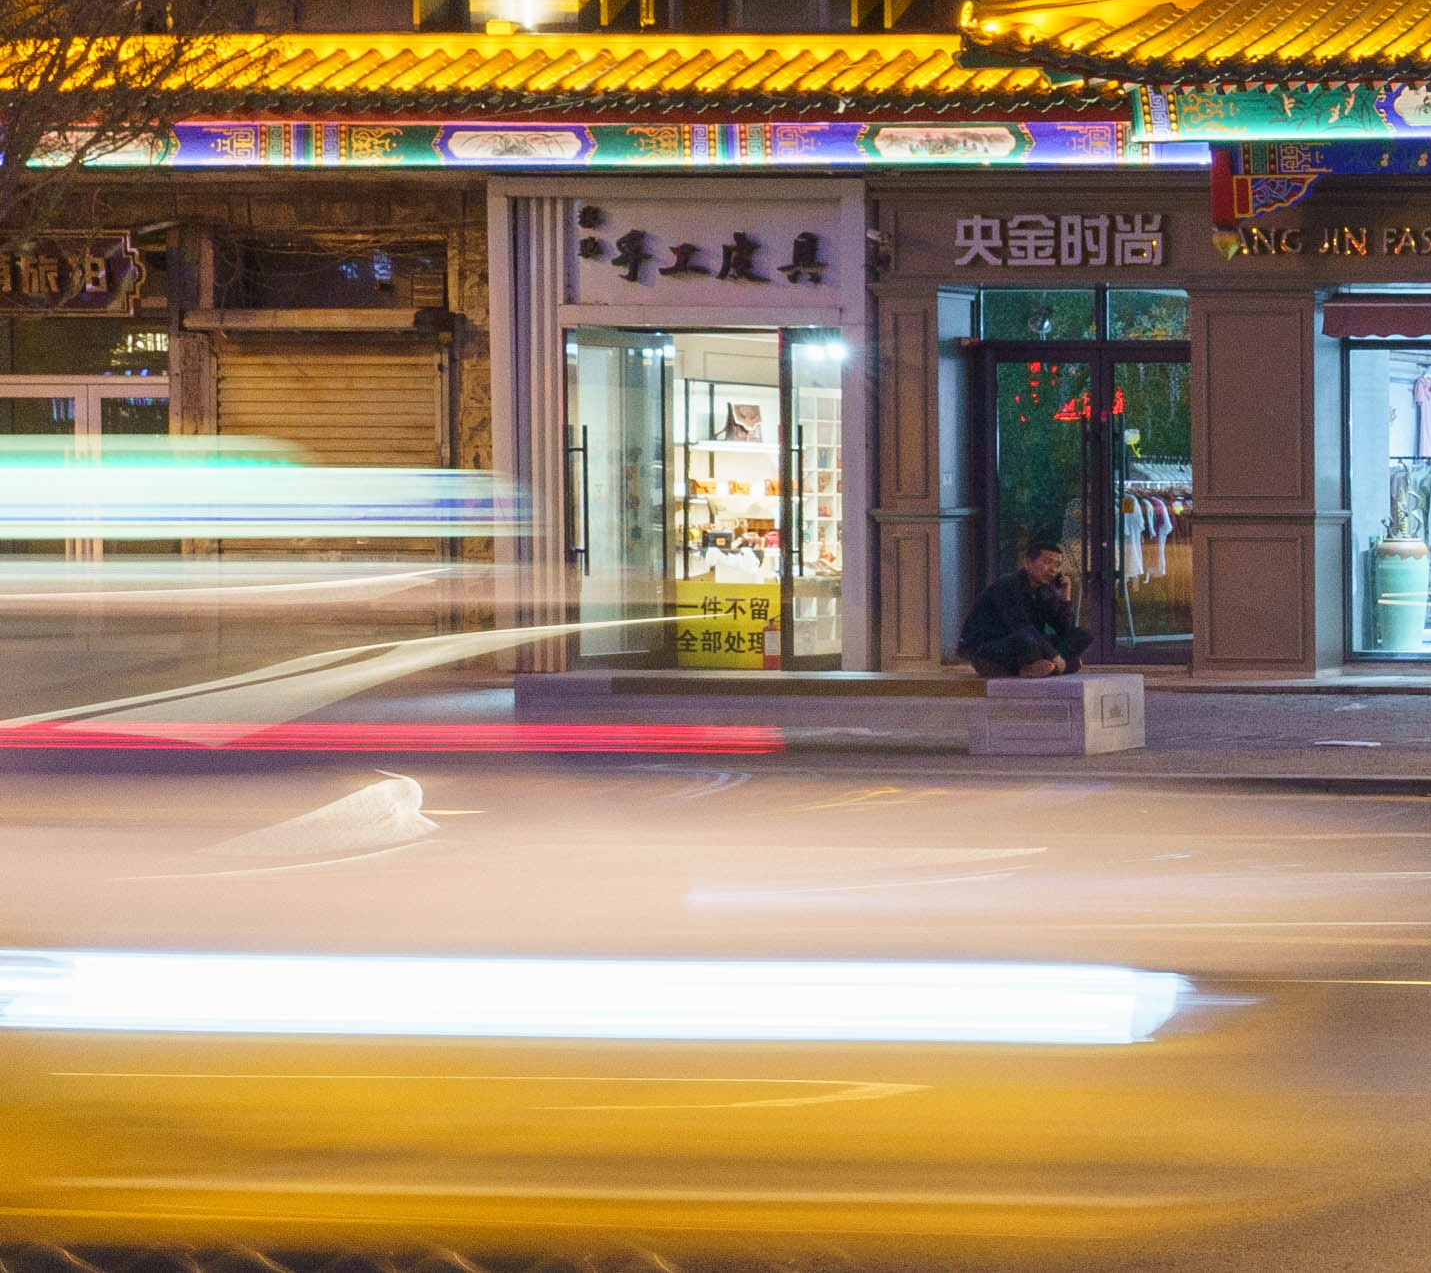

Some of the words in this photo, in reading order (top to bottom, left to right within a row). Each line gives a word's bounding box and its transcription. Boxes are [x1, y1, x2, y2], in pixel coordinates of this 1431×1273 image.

[954, 214, 1163, 265] 央金时尚
[1319, 227, 1367, 256] JIN
[611, 229, 828, 283] 手工皮具
[664, 596, 770, 621] 一件不留
[679, 630, 764, 654] 全部处理
